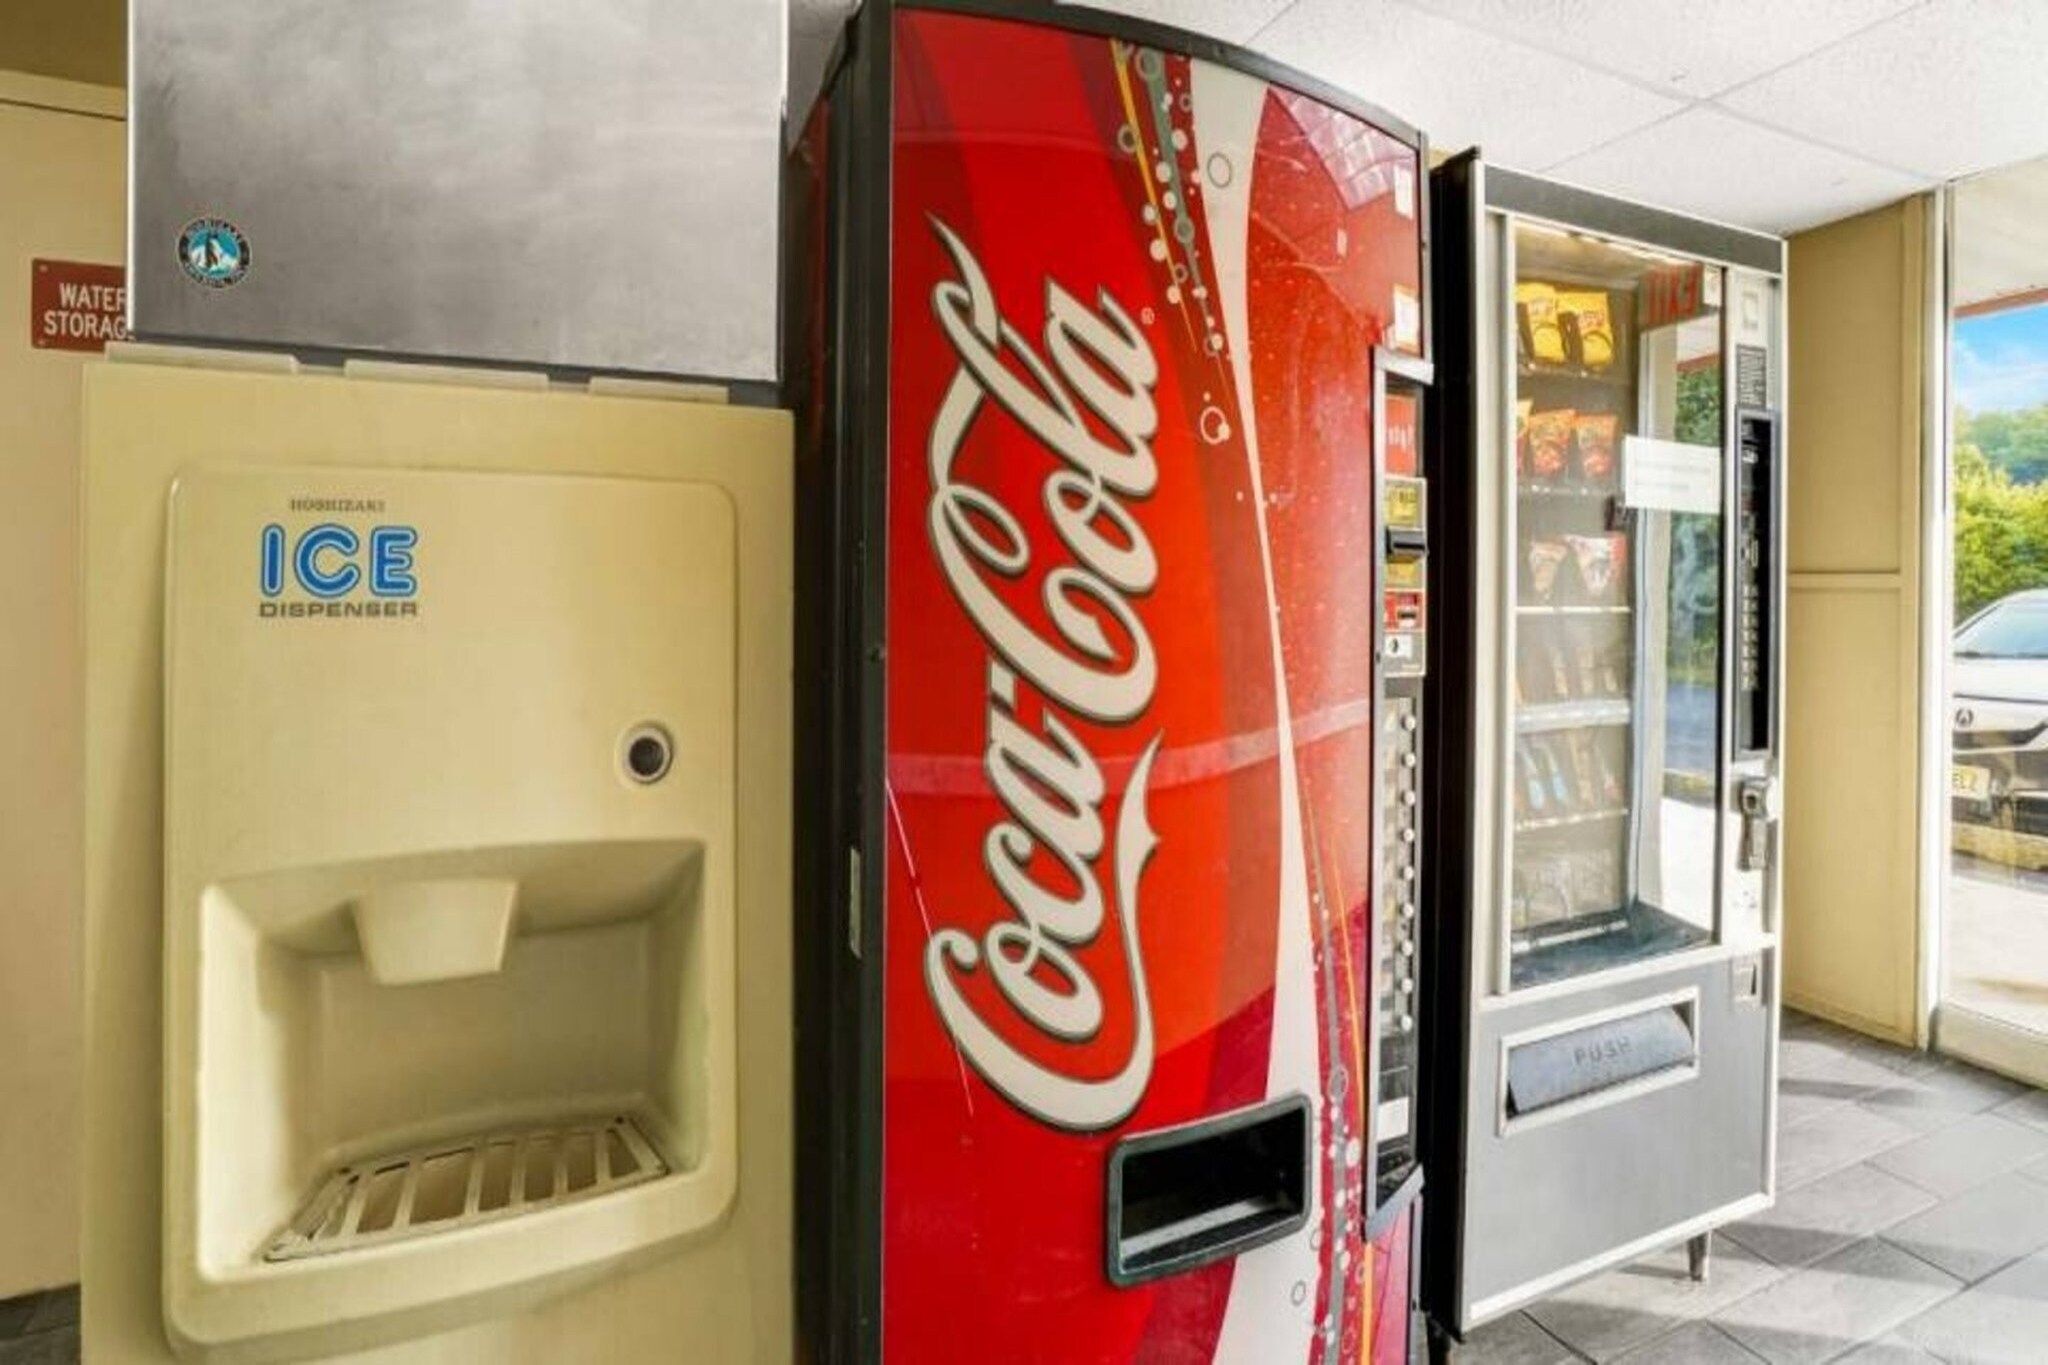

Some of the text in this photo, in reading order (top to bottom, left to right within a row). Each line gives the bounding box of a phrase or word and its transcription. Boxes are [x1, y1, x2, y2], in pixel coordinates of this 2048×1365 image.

[44, 309, 136, 340] STORAG
[262, 523, 418, 599] ICE
[259, 602, 417, 618] DISPENSER
[926, 211, 1160, 1132] Coca-Cola
[1574, 1036, 1632, 1065] PUSH
